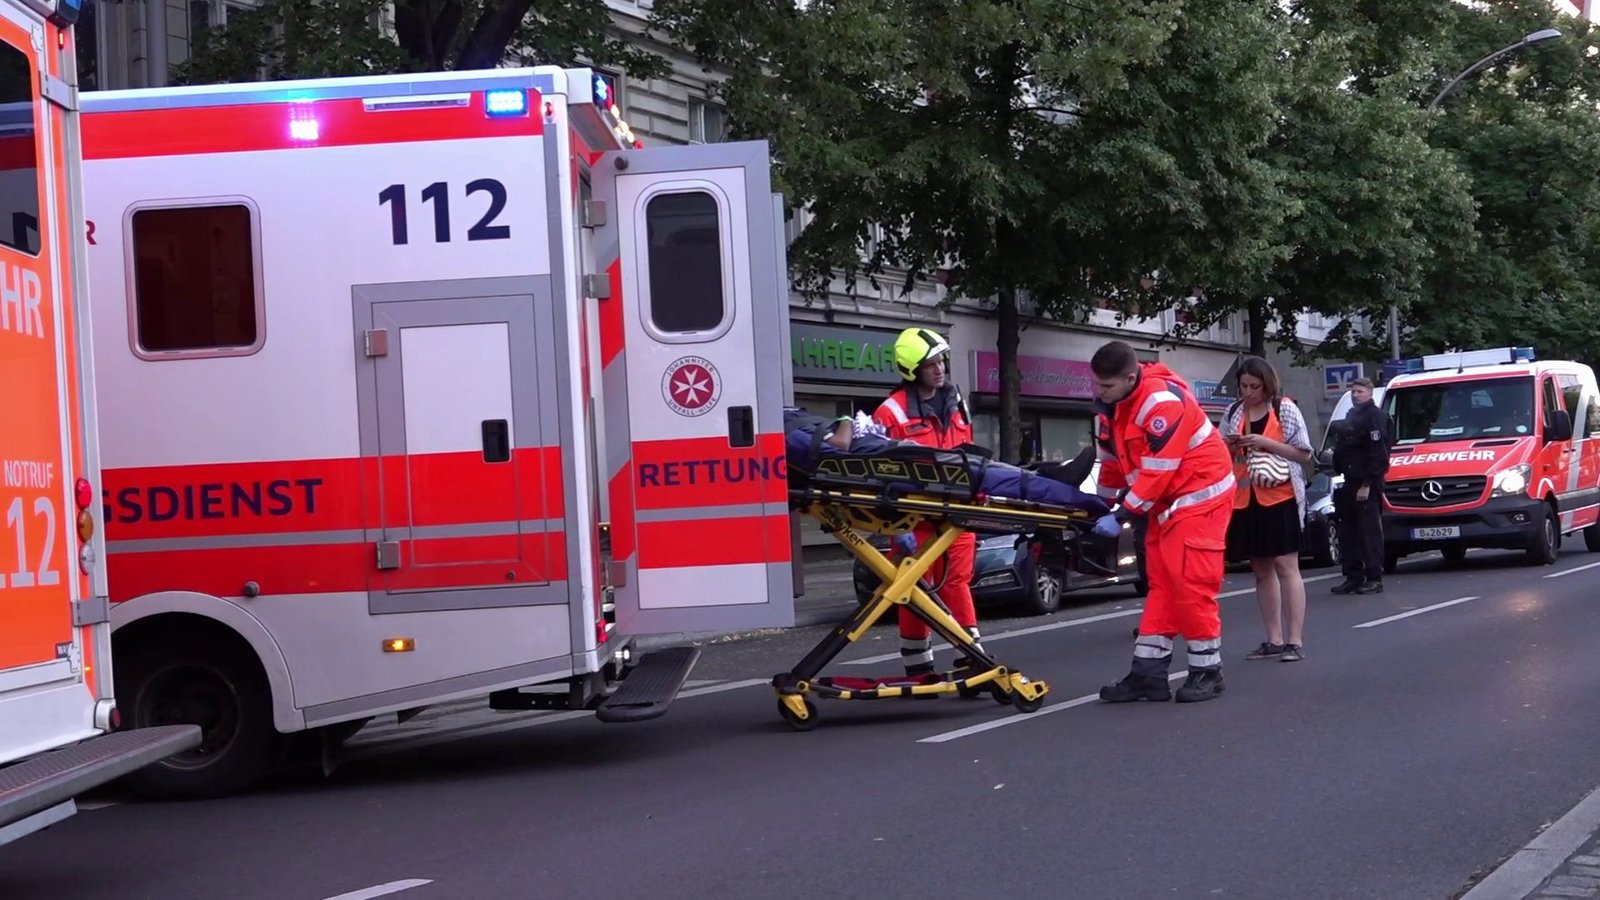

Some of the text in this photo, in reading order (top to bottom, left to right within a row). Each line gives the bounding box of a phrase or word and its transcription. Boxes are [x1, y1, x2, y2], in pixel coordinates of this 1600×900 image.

[378, 178, 511, 246] 112
[3, 460, 54, 488] NOTRUF
[0, 496, 60, 589] 12
